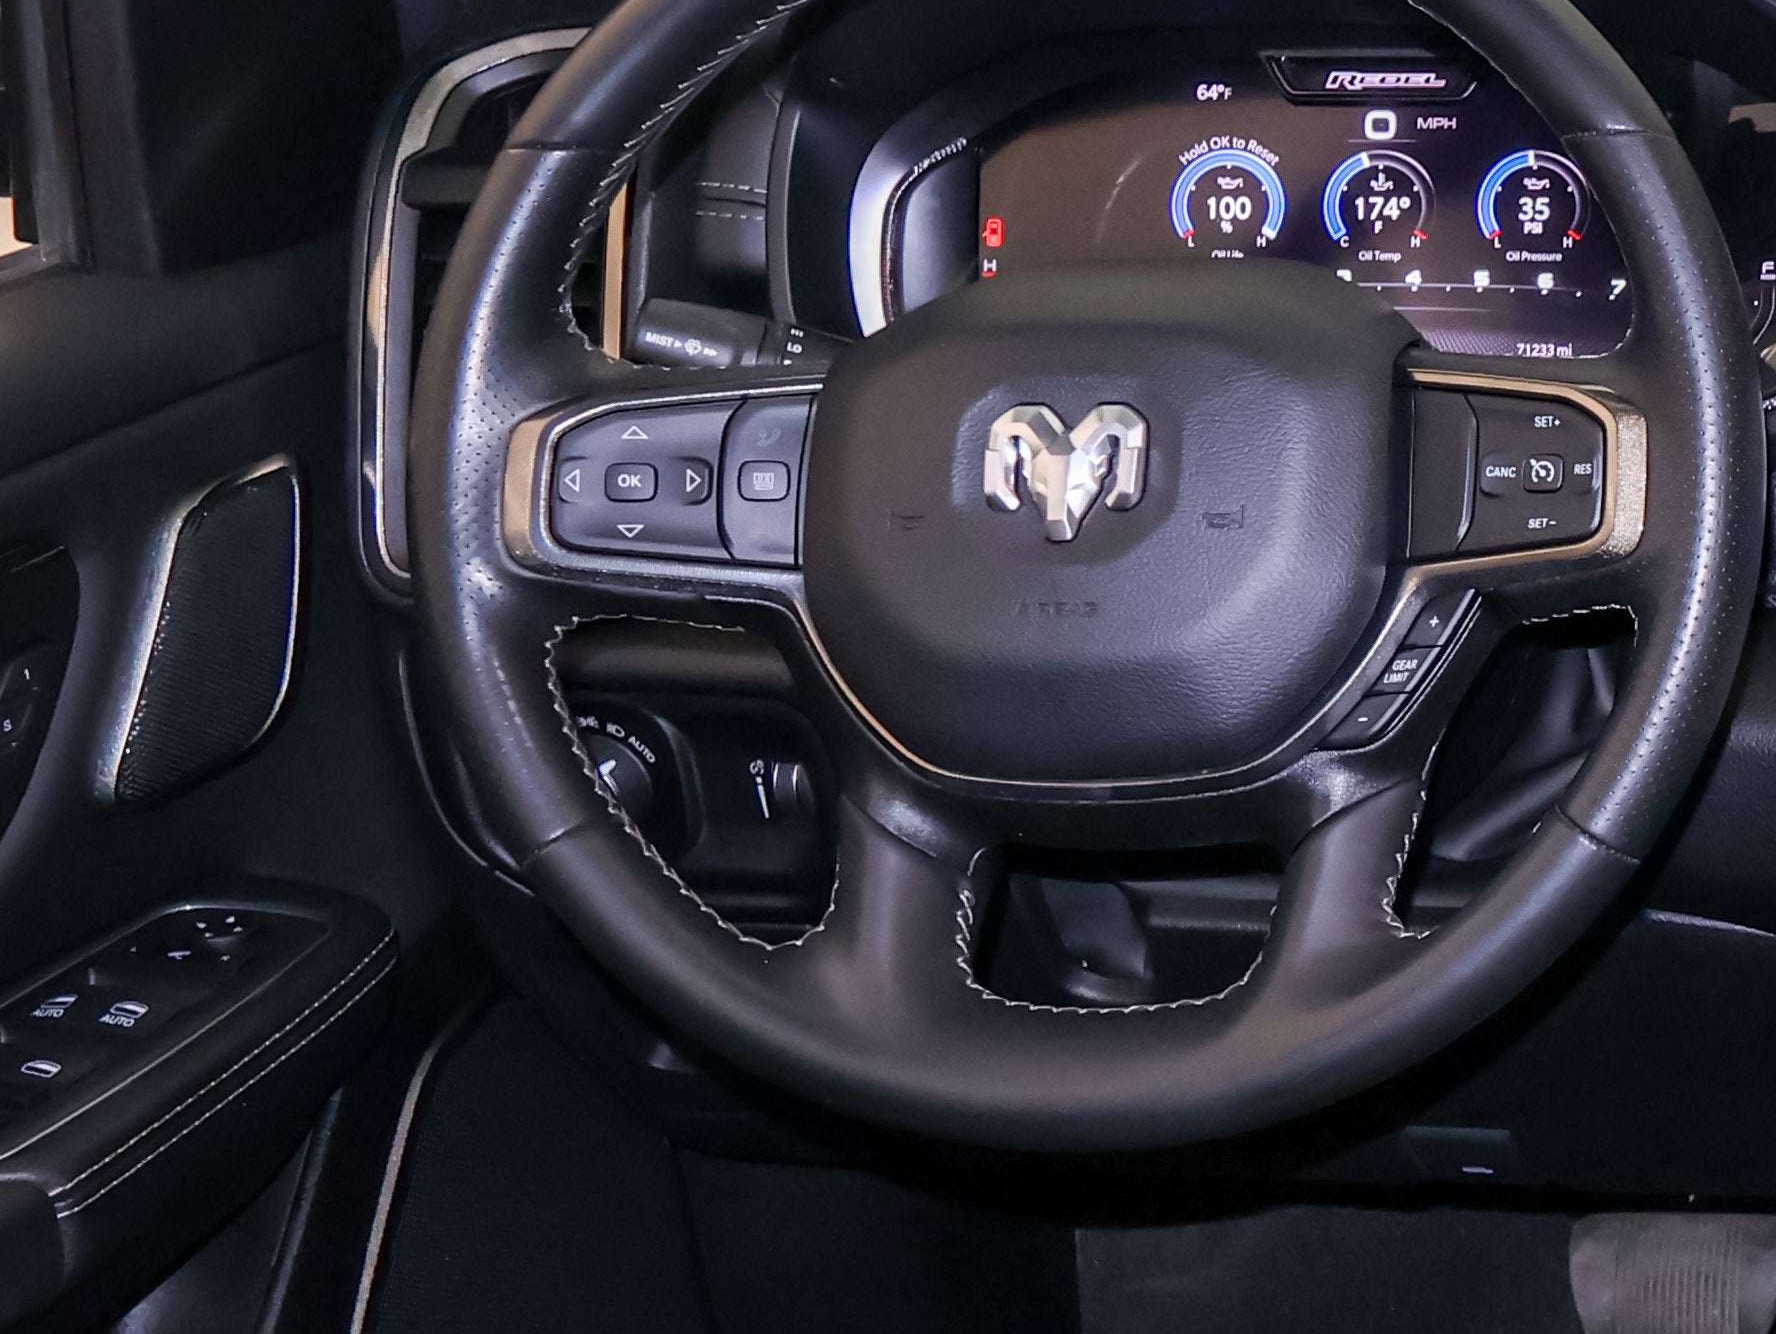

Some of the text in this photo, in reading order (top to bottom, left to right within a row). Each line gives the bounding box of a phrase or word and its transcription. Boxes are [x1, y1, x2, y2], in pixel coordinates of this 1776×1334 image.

[1364, 109, 1398, 141] 0
[1416, 117, 1458, 130] MPH
[1178, 135, 1280, 166] Hold OK to Reset
[1206, 196, 1252, 220] 100
[1354, 196, 1411, 220] 174°
[1517, 197, 1550, 221] 35
[1374, 222, 1383, 234] F
[1523, 222, 1543, 234] PSI
[1256, 235, 1266, 247] H
[1340, 235, 1350, 247] C
[1410, 235, 1421, 247] H
[1493, 236, 1502, 248] L
[1562, 236, 1573, 248] H
[1358, 250, 1401, 263] Oil Temp
[1506, 251, 1562, 262] Oil Pressure
[983, 259, 997, 272] H
[1404, 270, 1554, 288] 4 5 6
[645, 331, 674, 348] MIST
[787, 342, 802, 354] LO
[1516, 343, 1573, 357] 71233 mi
[1486, 466, 1516, 478] CANC
[1574, 464, 1592, 475] RES
[617, 474, 641, 488] OK
[1392, 660, 1418, 671] GEAR
[1384, 672, 1410, 683] LIMIT
[628, 737, 656, 764] AUTO
[31, 1008, 65, 1018] AUTO
[99, 1014, 135, 1027] AUTO
